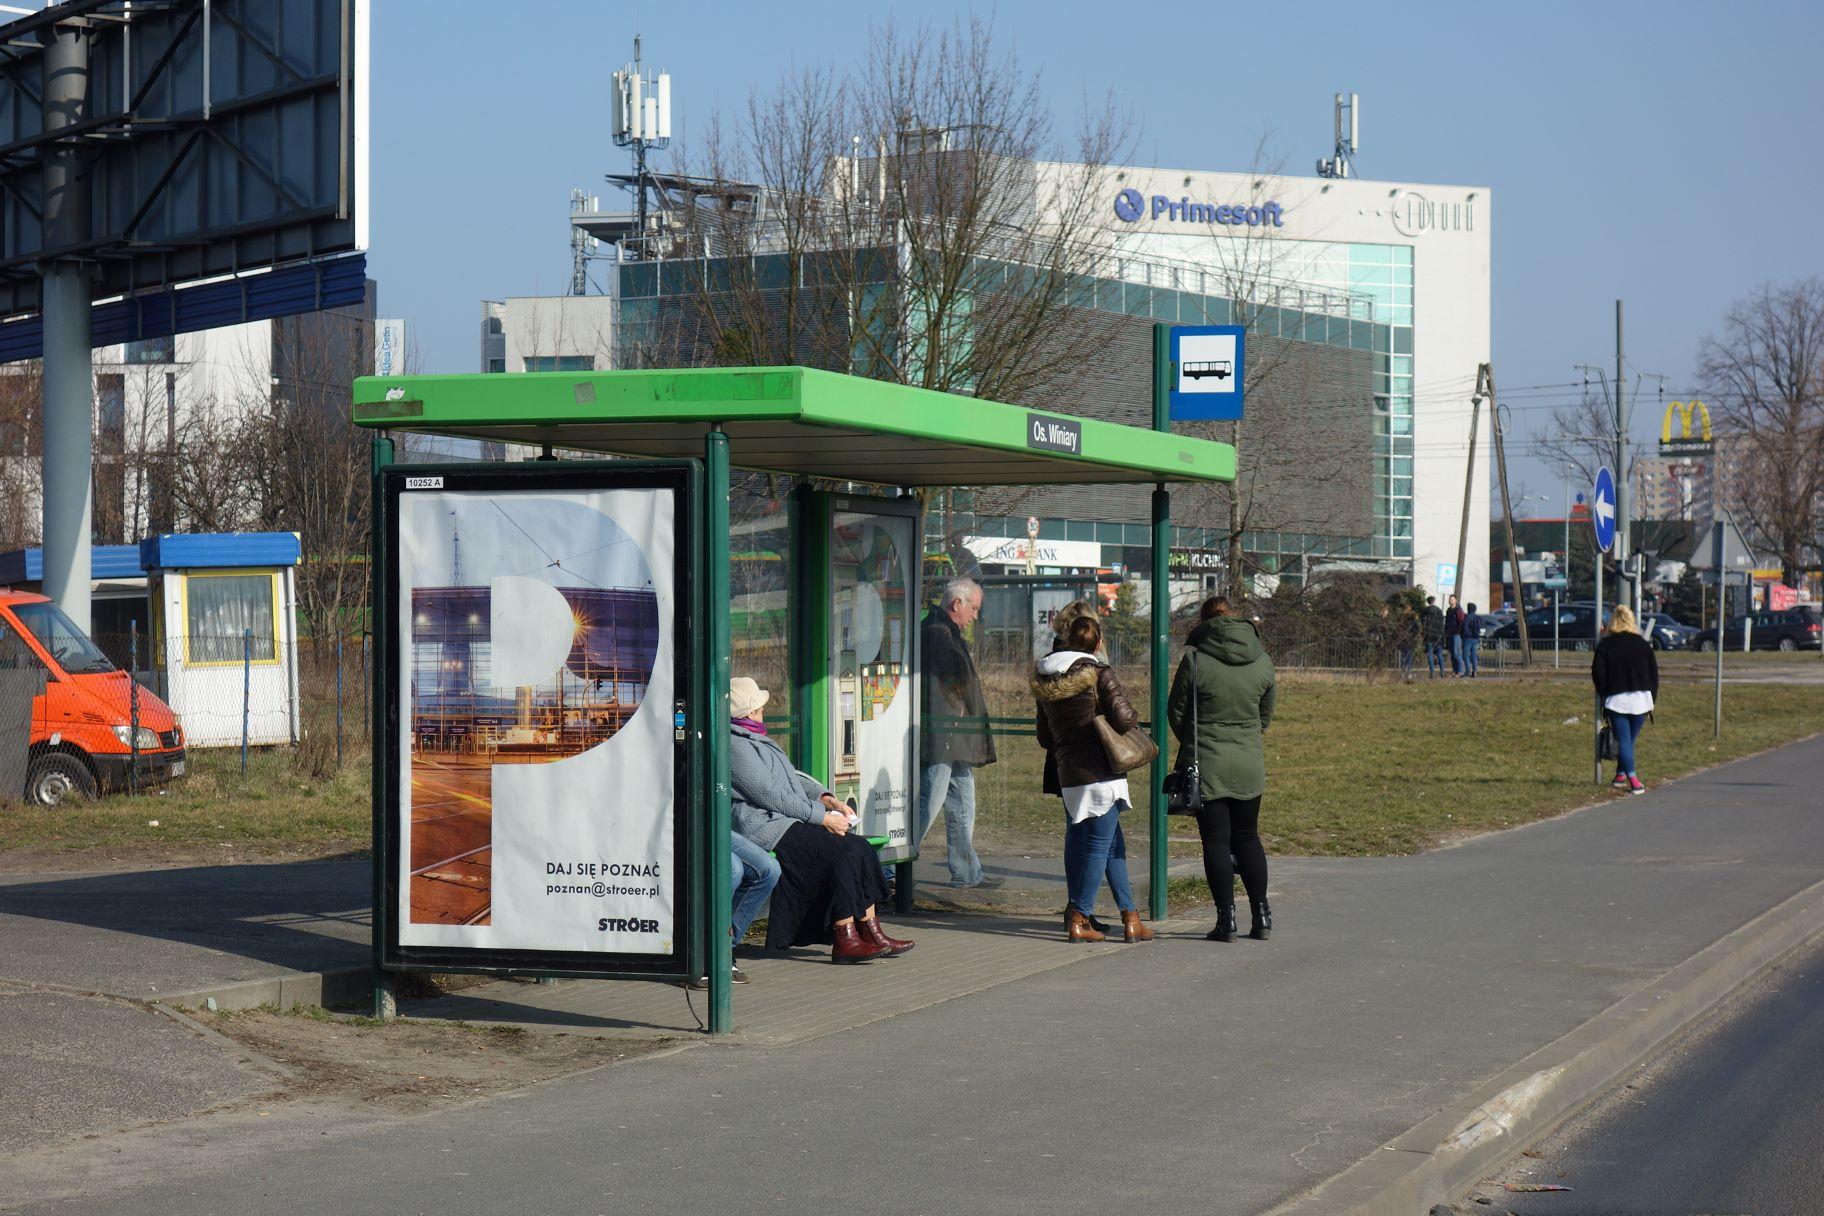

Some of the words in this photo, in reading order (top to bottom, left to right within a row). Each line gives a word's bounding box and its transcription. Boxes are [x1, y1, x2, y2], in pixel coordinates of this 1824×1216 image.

[1151, 195, 1284, 228] Primesoft
[1033, 420, 1048, 442] Os.
[1048, 423, 1078, 452] Winiary
[408, 478, 433, 488] 10252
[434, 478, 441, 487] A
[995, 545, 1015, 560] ING
[1036, 547, 1058, 561] ANK
[546, 862, 572, 875] DAJ
[577, 863, 596, 879] SIĘ
[601, 861, 660, 877] POZNAĆ
[546, 881, 660, 899] poznan@stroeer.pl
[598, 917, 660, 934] STRÖER
